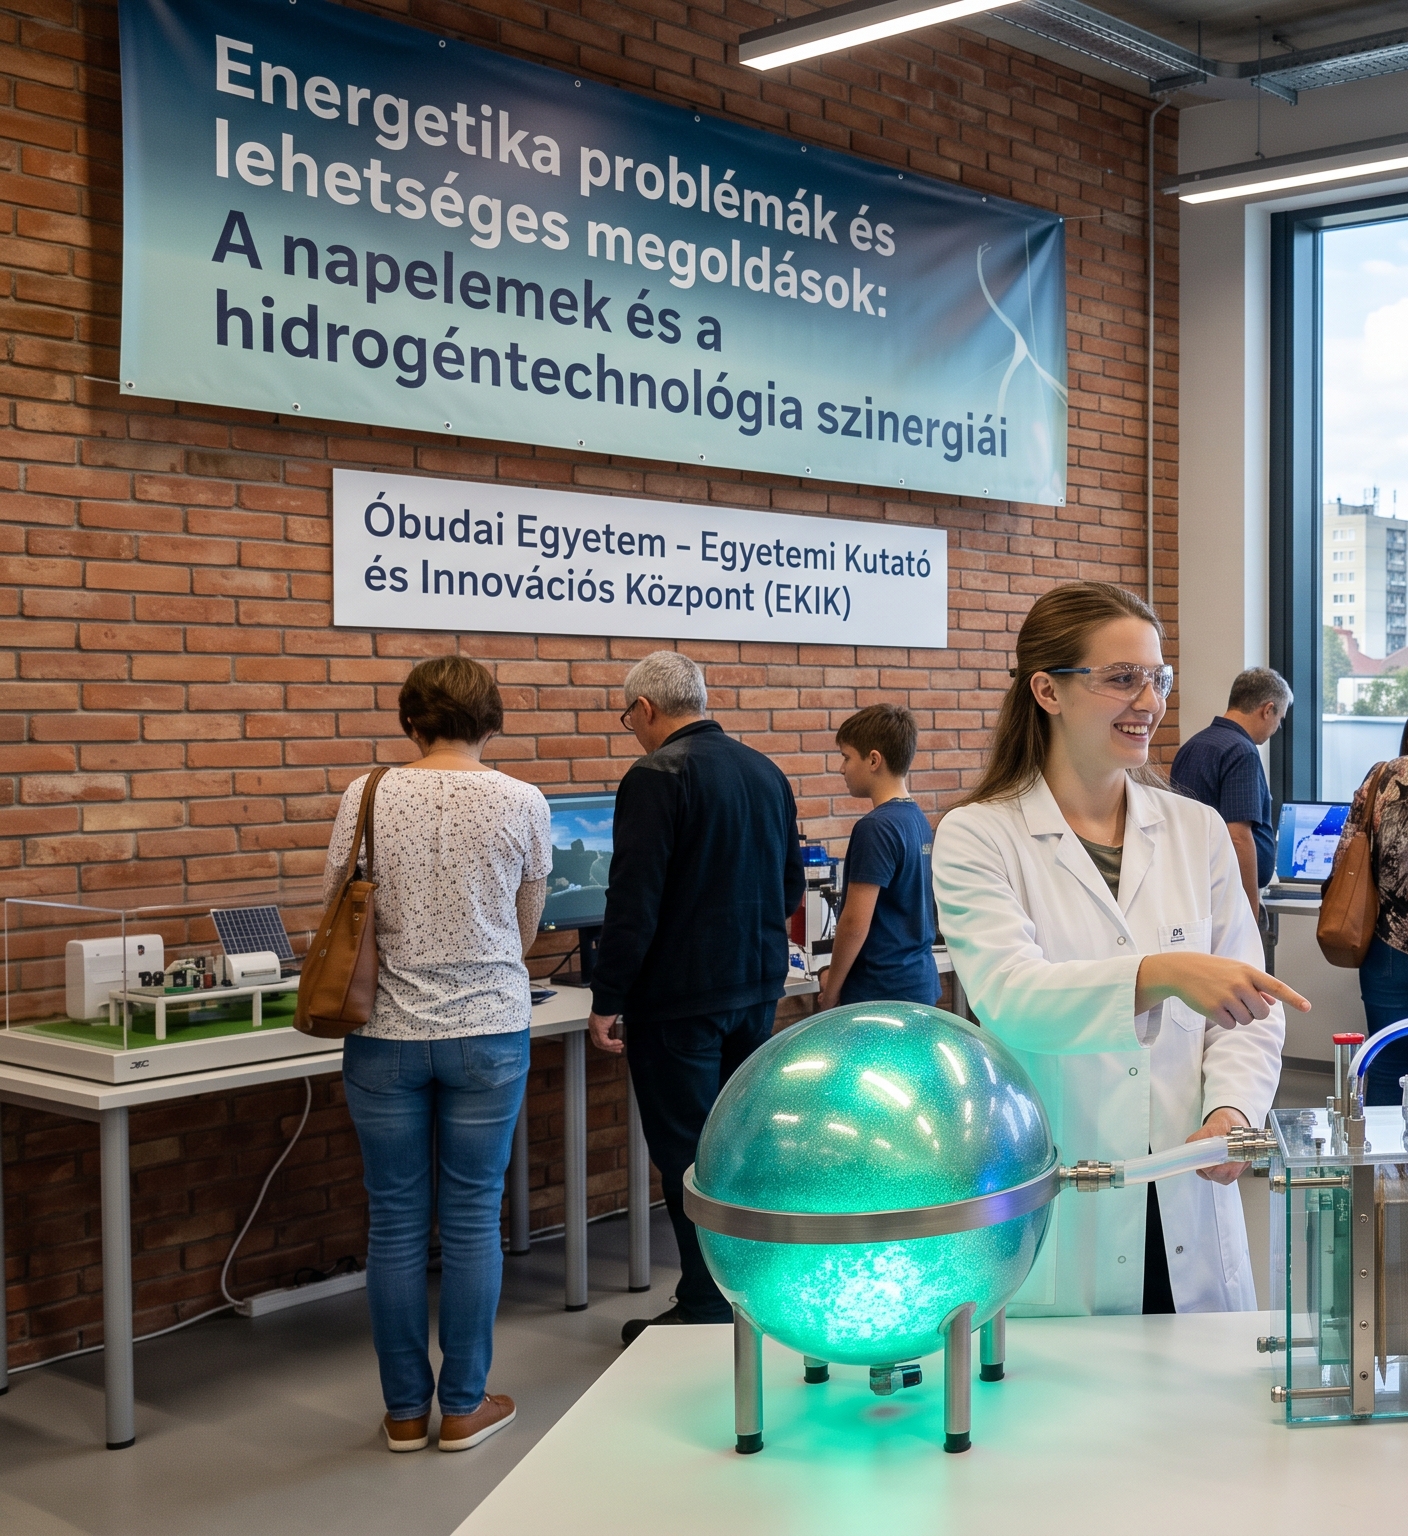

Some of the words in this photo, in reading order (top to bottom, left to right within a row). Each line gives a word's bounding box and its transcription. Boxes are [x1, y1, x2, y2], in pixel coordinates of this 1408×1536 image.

[215, 34, 561, 177] Energetika
[580, 146, 839, 245] problémák
[849, 205, 896, 257] és
[215, 117, 570, 251] lehetséges
[587, 220, 887, 317] megoldások:
[211, 209, 263, 270] A
[283, 234, 612, 333] napelemek
[626, 287, 682, 345] és
[696, 315, 722, 352] a
[215, 288, 803, 437] hidrogéntechnológia
[817, 397, 1008, 462] szinergiái
[364, 491, 504, 546] Óbudai
[517, 513, 666, 560] Egyetem
[701, 530, 836, 573] Egyetemi
[845, 543, 931, 578] Kutató
[364, 554, 409, 593] és
[422, 559, 615, 604] Innovációs
[626, 572, 755, 616] Központ
[764, 579, 852, 622] (EKIK)
